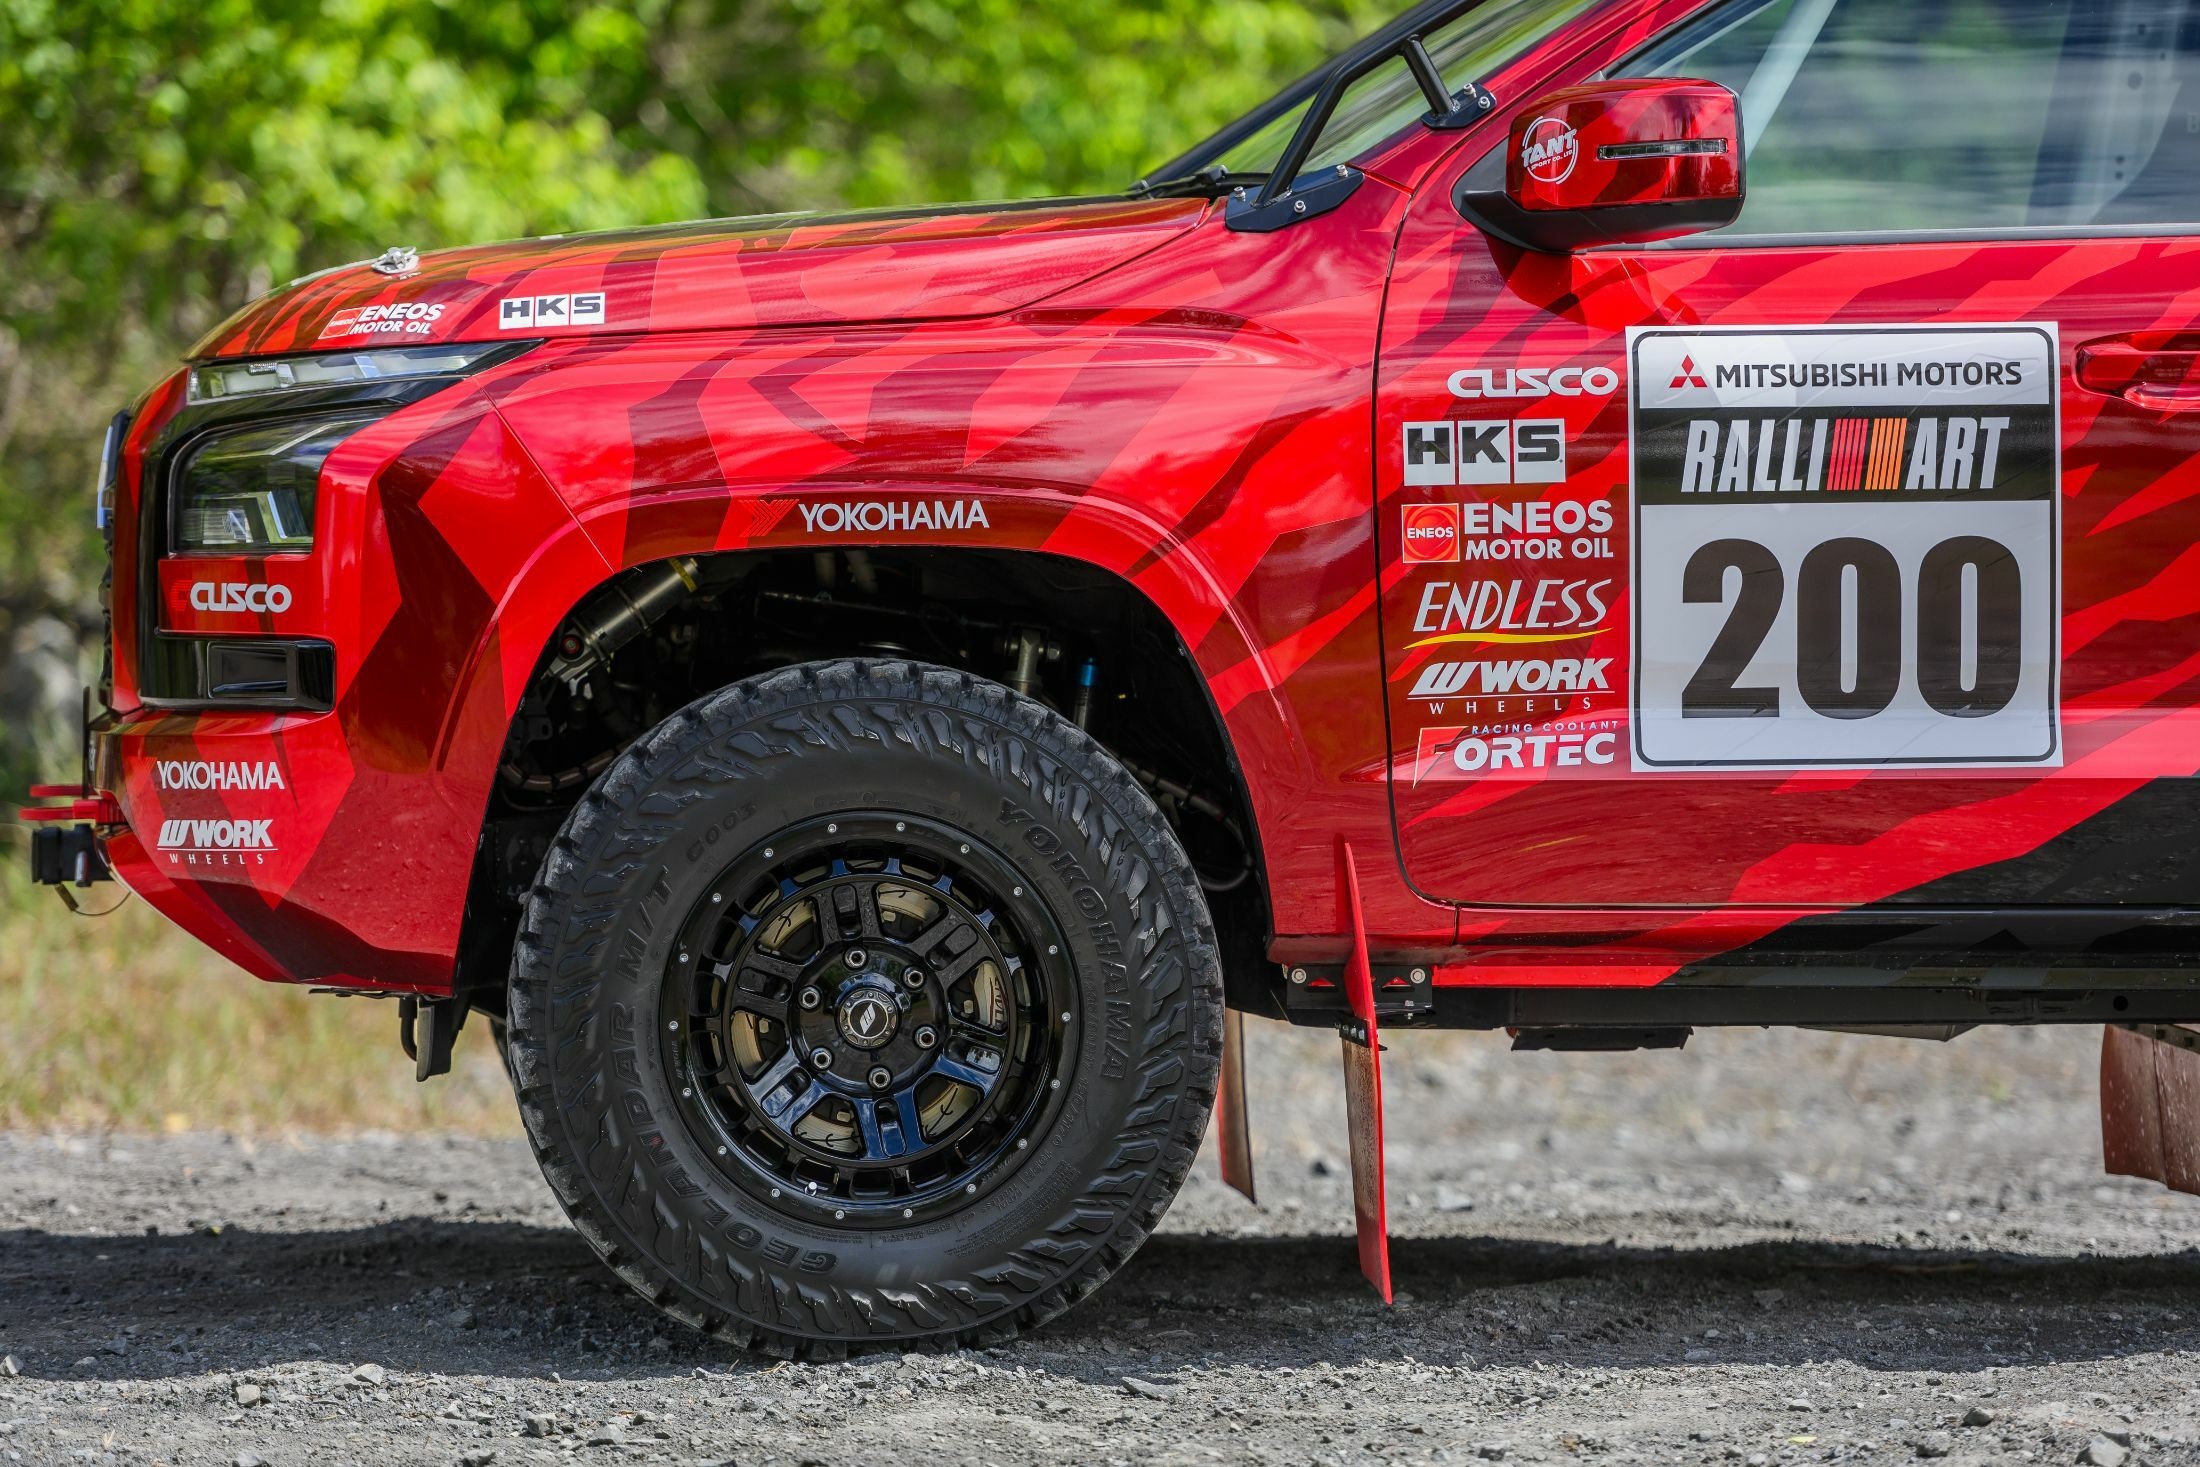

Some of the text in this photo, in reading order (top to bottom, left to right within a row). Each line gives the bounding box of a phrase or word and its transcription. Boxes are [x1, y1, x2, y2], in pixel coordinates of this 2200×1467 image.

[1521, 129, 1577, 168] TANT
[358, 303, 446, 322] ENEOS
[502, 295, 601, 319] HKS
[349, 320, 432, 335] MOTOR OIL
[1447, 367, 1618, 398] CUSCO
[1715, 361, 2023, 388] MITSUBISHI MOTORS
[1406, 424, 1566, 466] HKS
[798, 500, 990, 533] YOKOHAMA
[1464, 500, 1613, 534] ENEOS
[1407, 527, 1454, 538] ENEOS
[1465, 538, 1613, 561] MOTOR OIL
[190, 581, 292, 613] CUSCO
[1413, 578, 1612, 632] ENDLESS
[1682, 536, 2021, 719] 200
[1481, 657, 1614, 693] WORK
[1429, 697, 1591, 715] WHEELS
[1471, 720, 1618, 736] RACING COOLANT
[157, 760, 285, 790] YOKOHAMA
[191, 819, 273, 848] WORK
[169, 853, 264, 865] WHEELS
[996, 797, 1131, 1080] YOKOHAMA
[608, 1001, 839, 1277] GEOLANDAR
